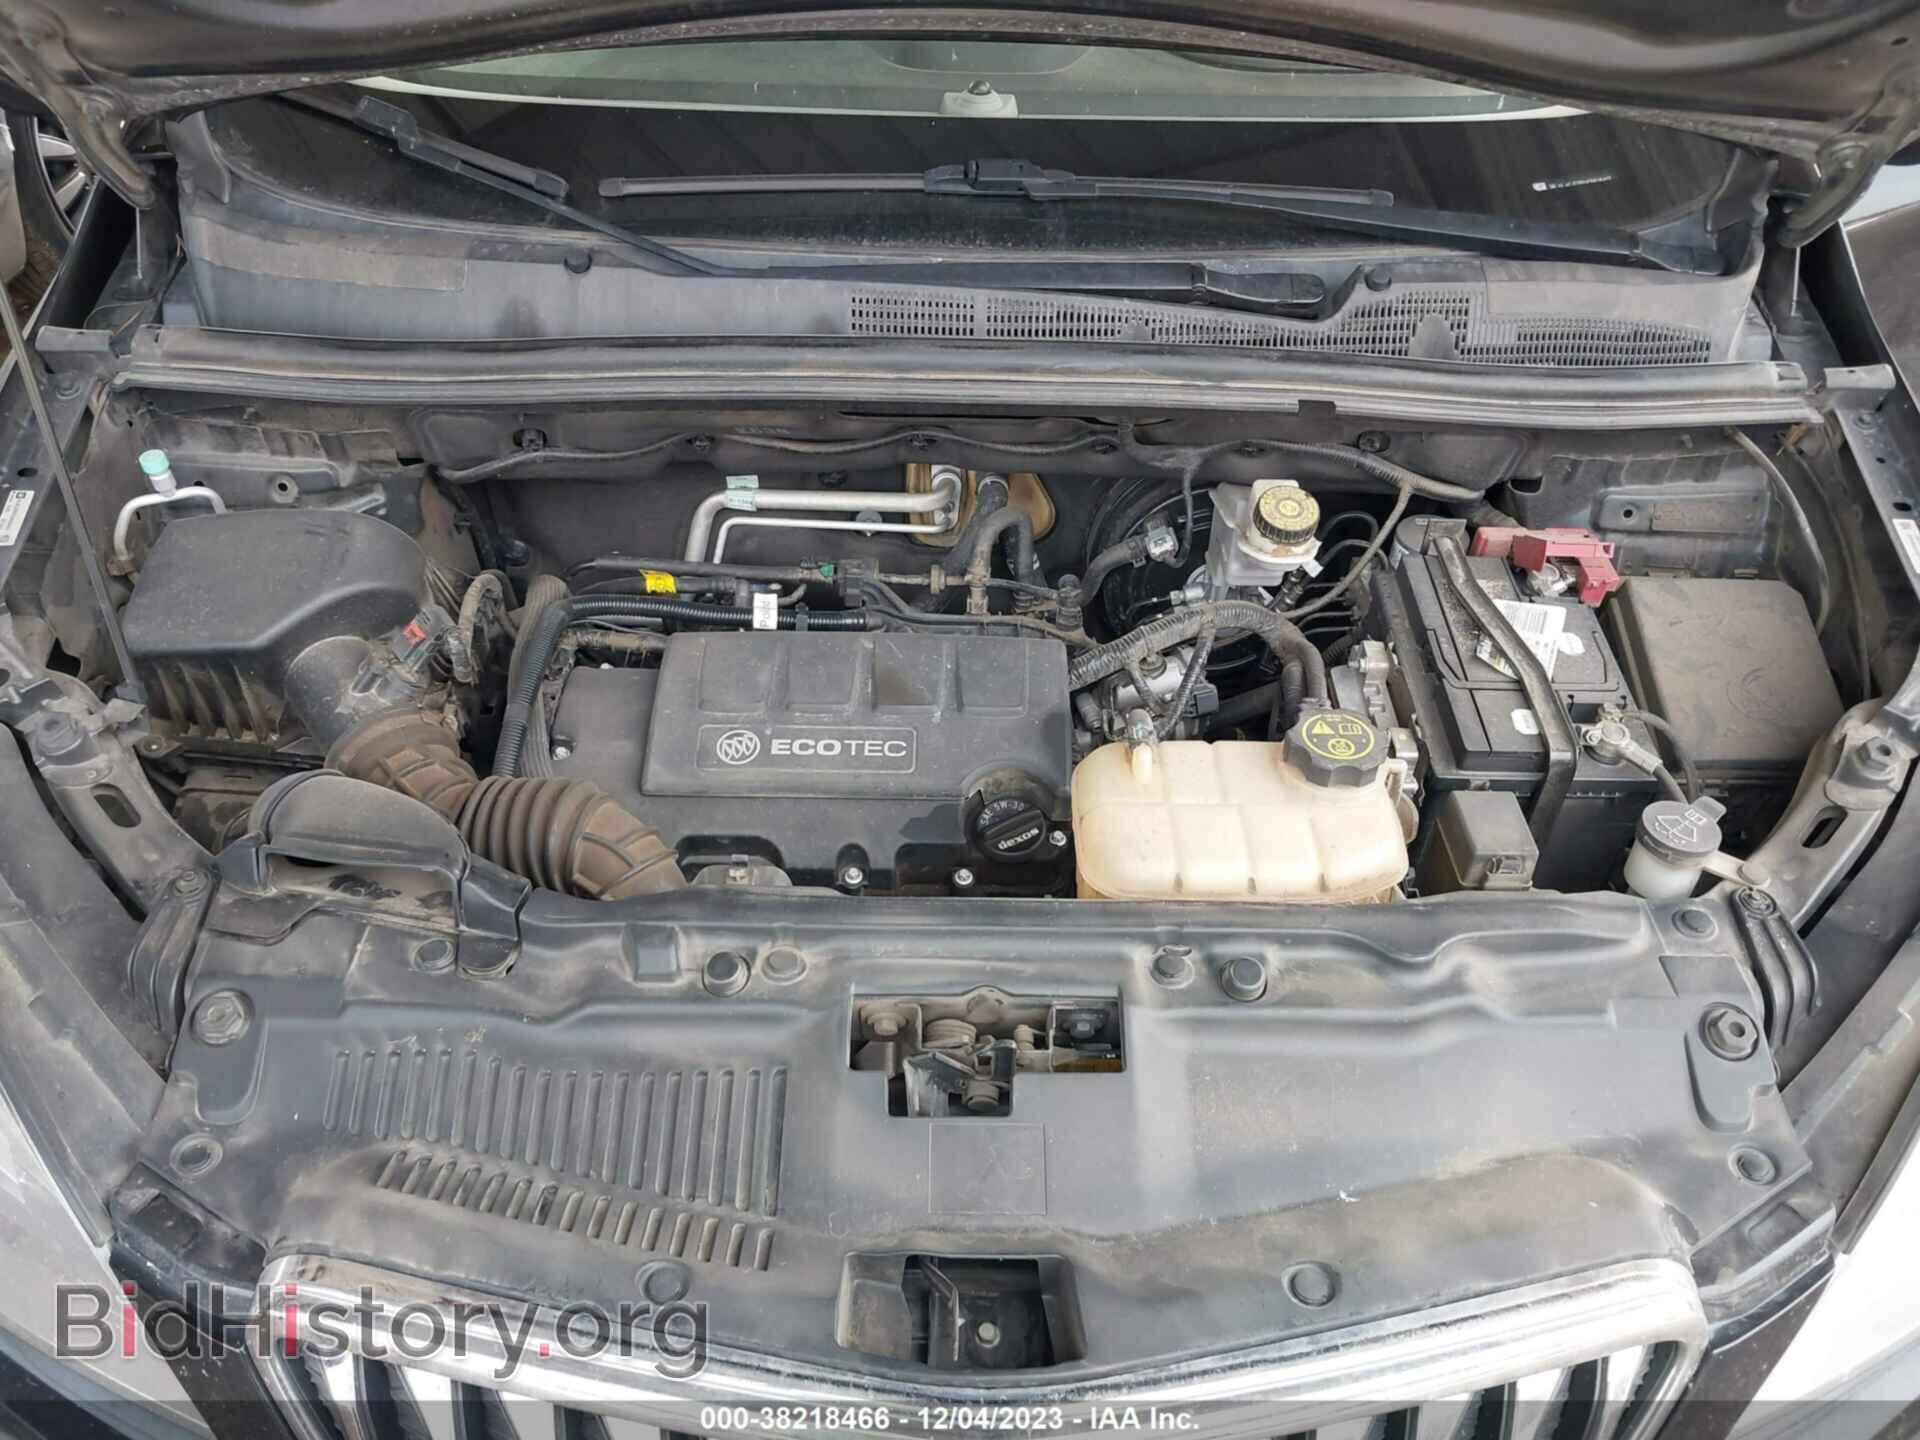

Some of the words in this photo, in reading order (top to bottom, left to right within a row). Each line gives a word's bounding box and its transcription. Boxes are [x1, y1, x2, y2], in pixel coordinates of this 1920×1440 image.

[770, 738, 908, 758] ECOTEC
[980, 807, 993, 825] SAE
[998, 827, 1040, 850] dexos
